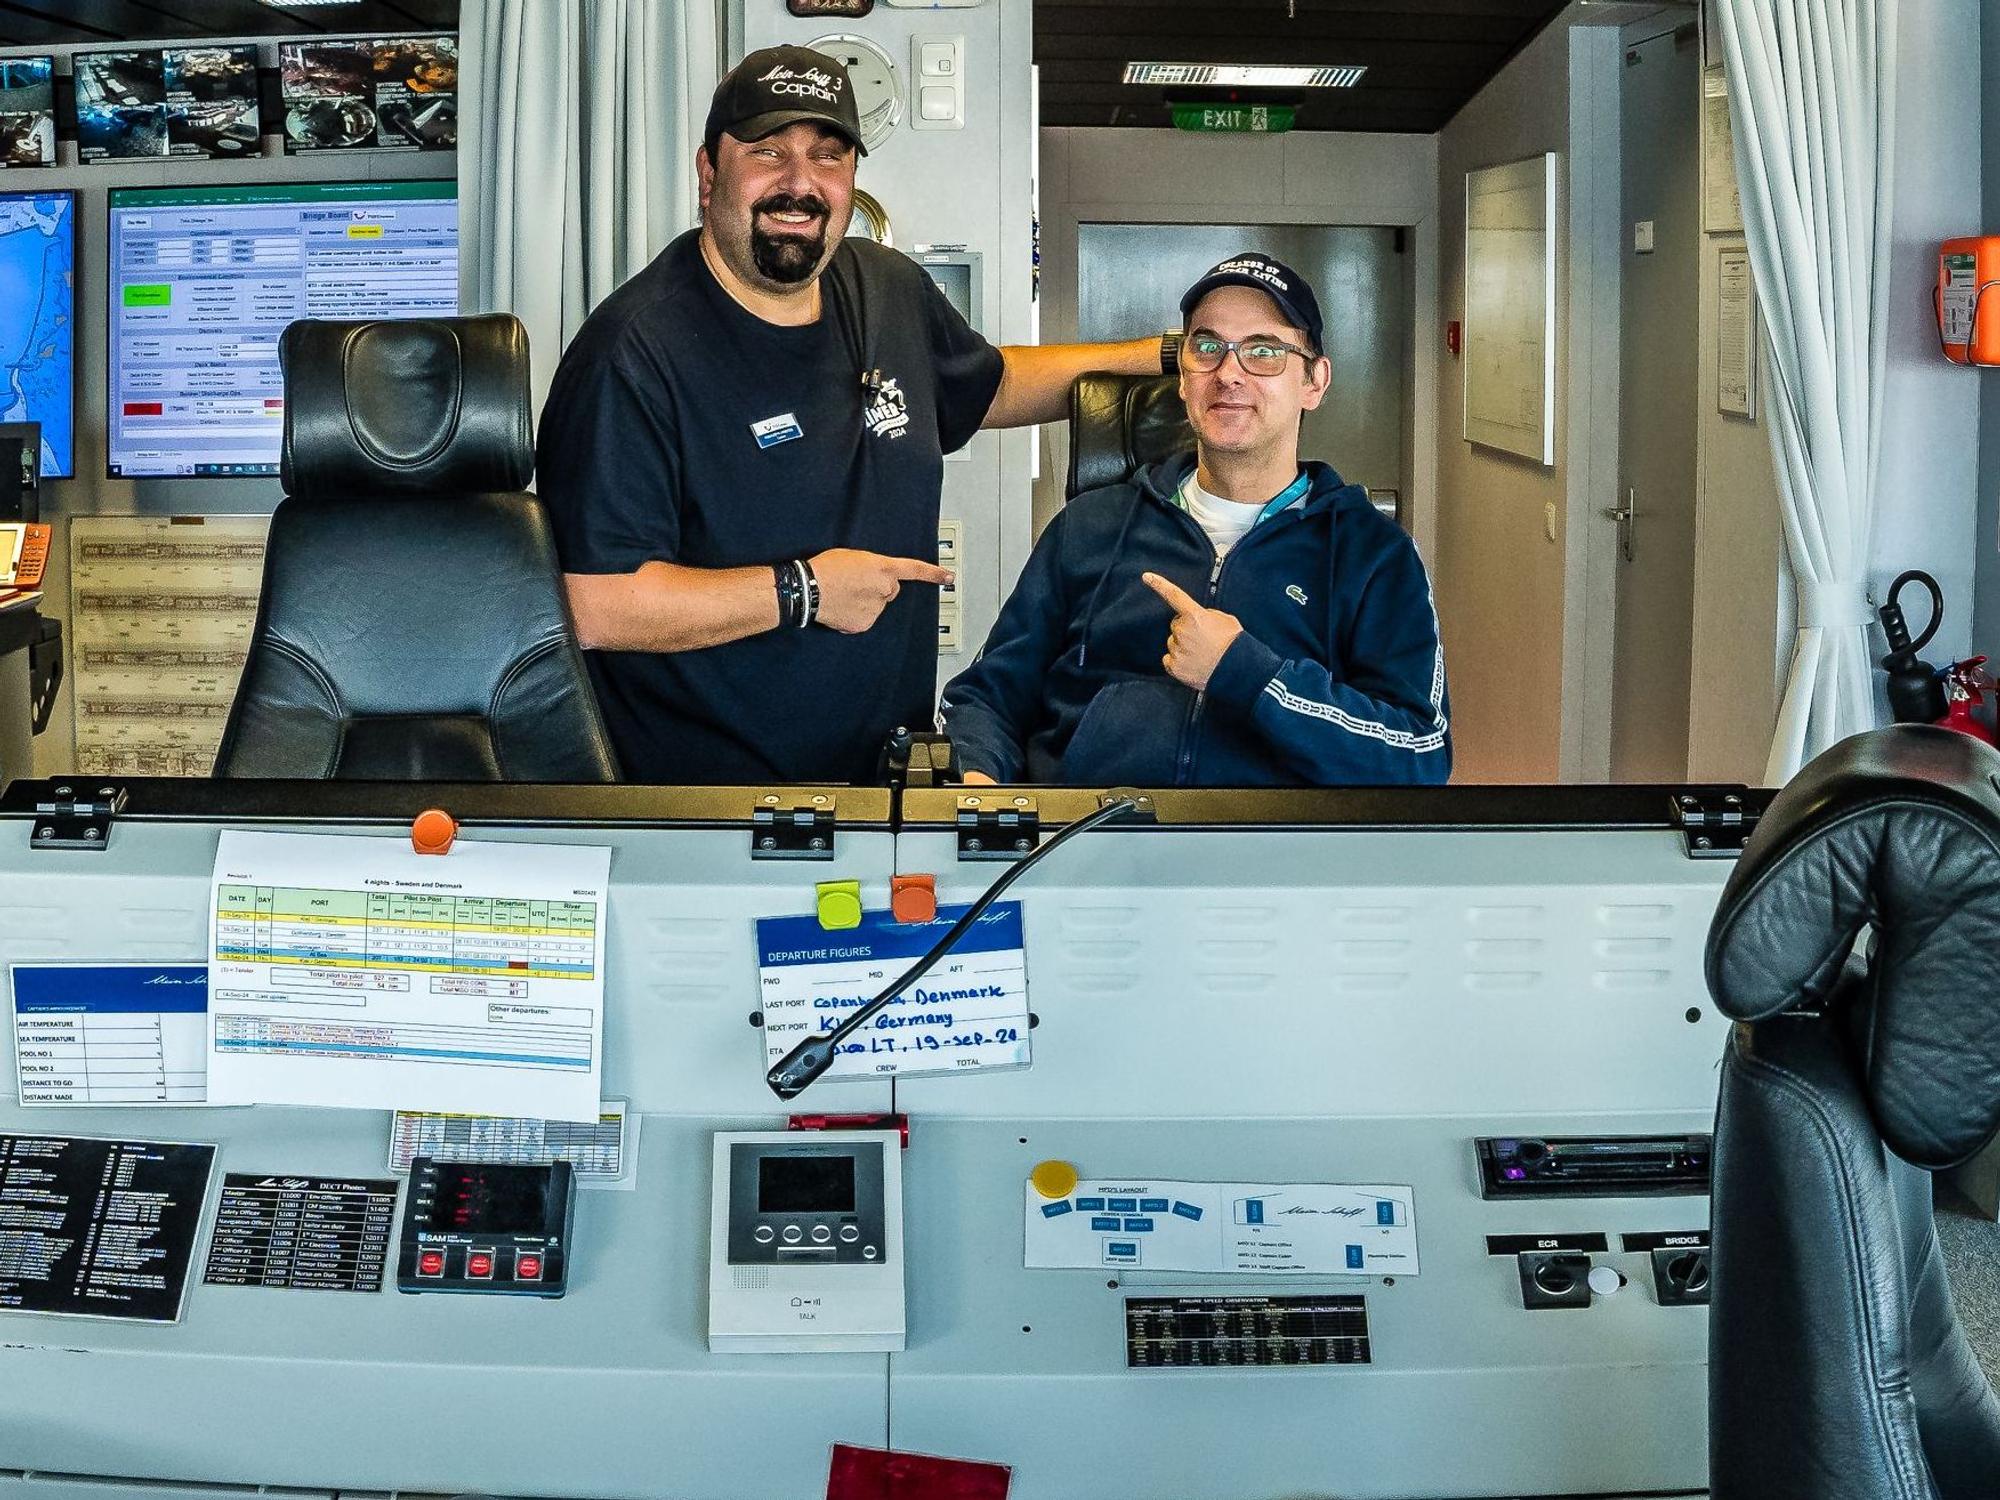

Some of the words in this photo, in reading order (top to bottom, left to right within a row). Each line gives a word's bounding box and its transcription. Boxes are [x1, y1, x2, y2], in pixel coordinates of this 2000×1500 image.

[758, 65, 793, 81] Mein
[795, 67, 831, 87] Schiff
[834, 78, 842, 90] 3
[1204, 110, 1241, 127] EXIT
[1265, 266, 1279, 275] OF
[889, 429, 906, 439] 2024
[768, 950, 828, 962] DEPARTURE
[829, 946, 872, 958] FIGURES
[143, 974, 182, 985] Mein
[326, 972, 340, 980] pilot
[764, 978, 780, 986] FWD
[869, 971, 883, 979] MID
[949, 965, 964, 973] AFT
[915, 985, 1005, 1004] Denmark
[766, 1001, 784, 1009] LAST
[785, 999, 806, 1007] PORT
[767, 1024, 788, 1032] NEXT
[789, 1022, 808, 1030] PORT
[770, 1047, 784, 1055] ETA
[876, 1064, 897, 1072] CREW
[1277, 1206, 1320, 1215] Mein
[1321, 1207, 1366, 1217] Schiff
[1538, 1240, 1559, 1248] ECR
[1665, 1236, 1700, 1245] BRIDGE
[317, 1281, 346, 1289] Manager
